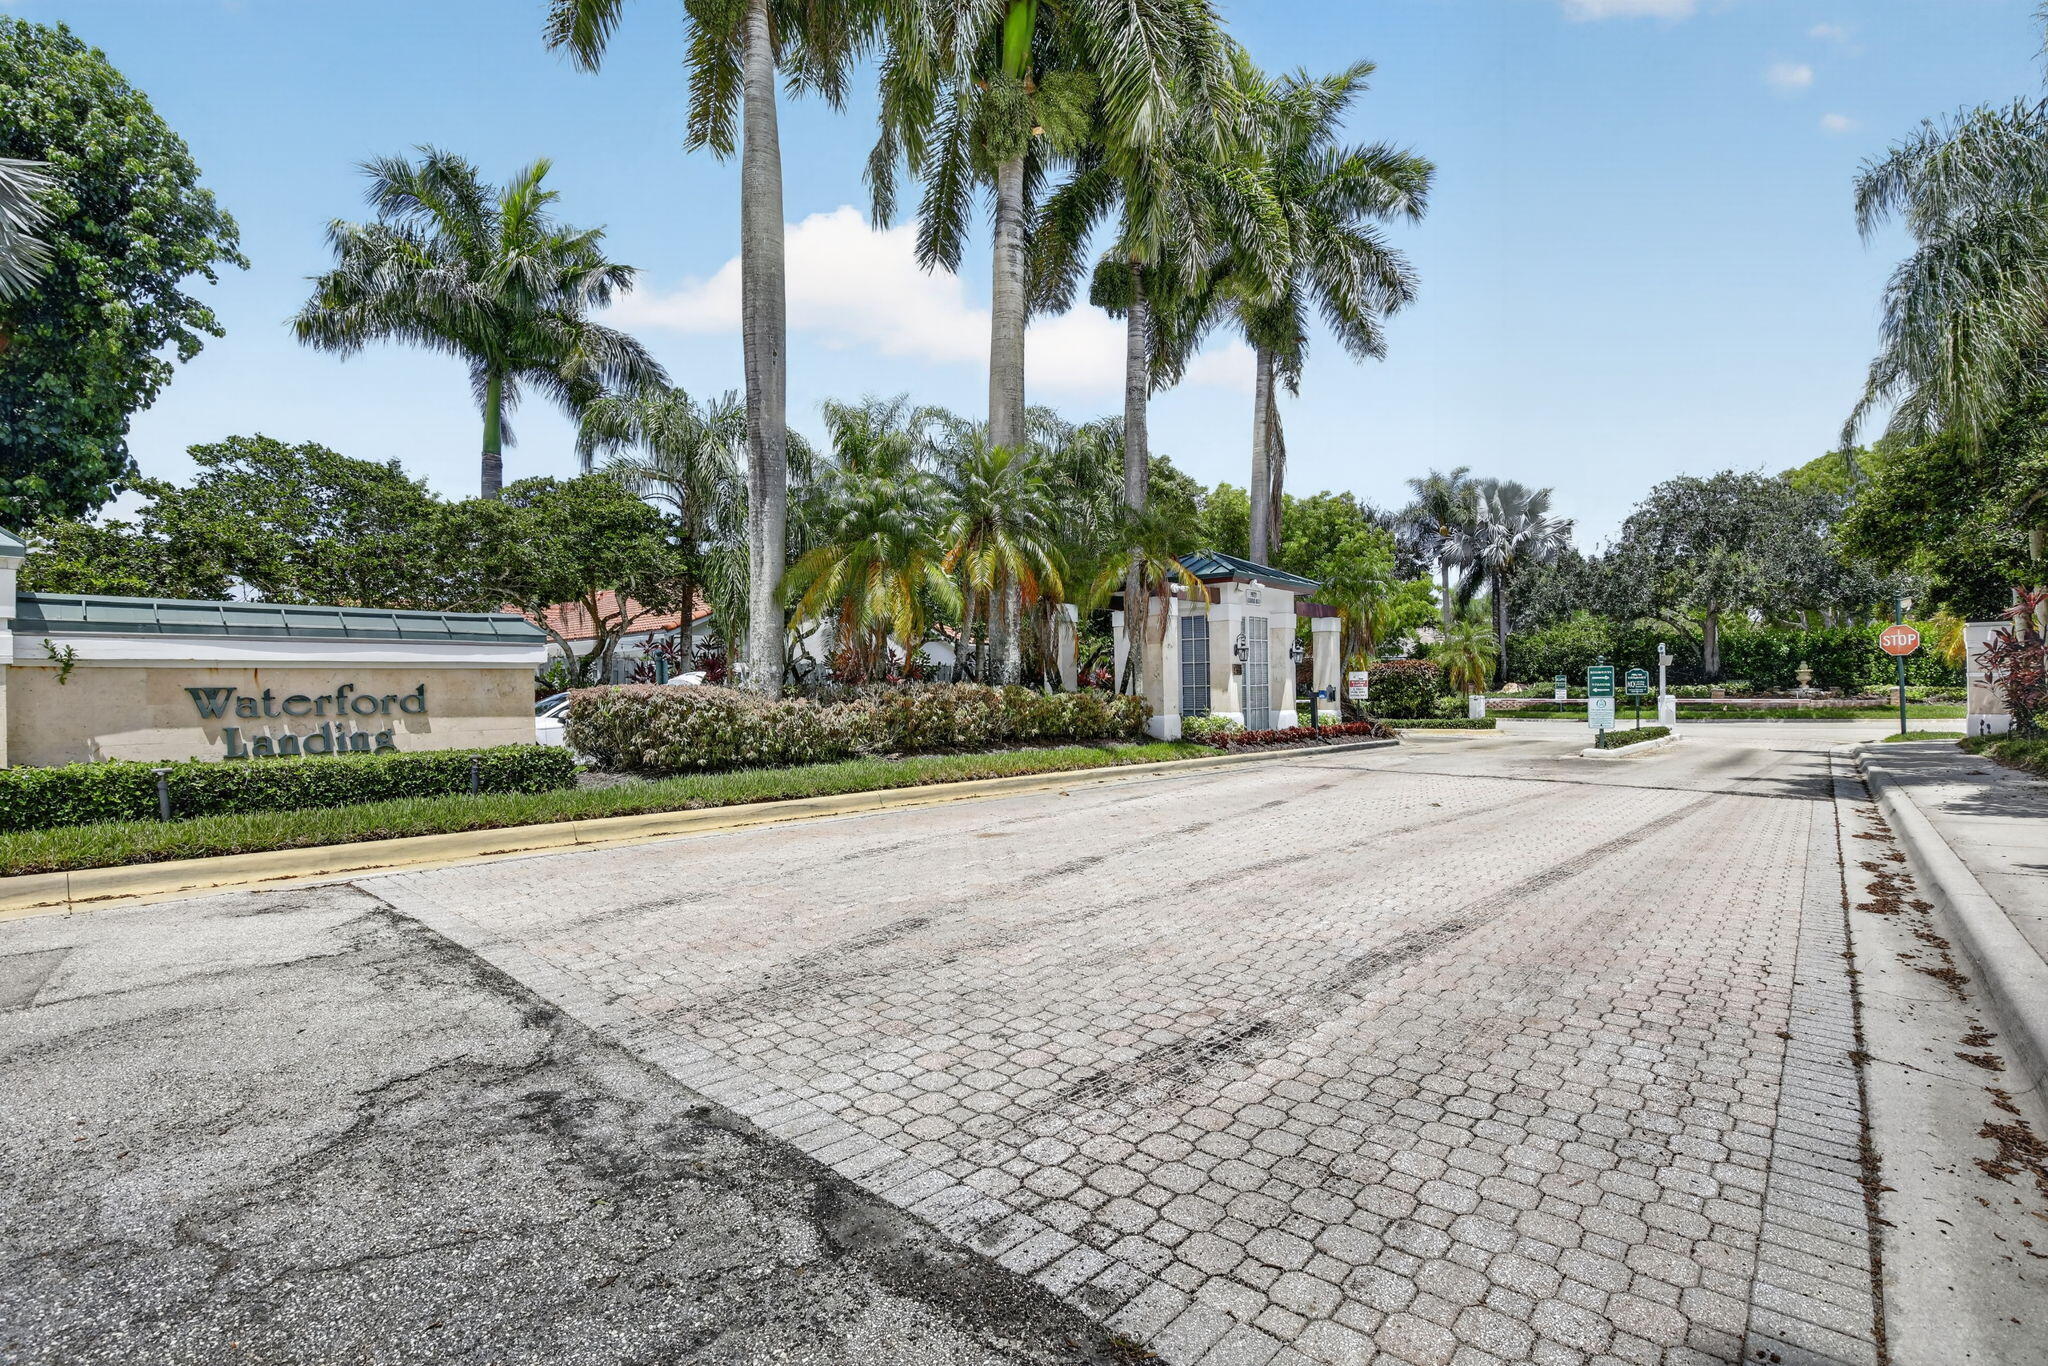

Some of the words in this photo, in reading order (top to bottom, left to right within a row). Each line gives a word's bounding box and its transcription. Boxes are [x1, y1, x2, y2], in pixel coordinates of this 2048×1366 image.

[1883, 634, 1916, 646] STOP
[184, 683, 428, 719] Waterford
[222, 720, 397, 759] Landing
